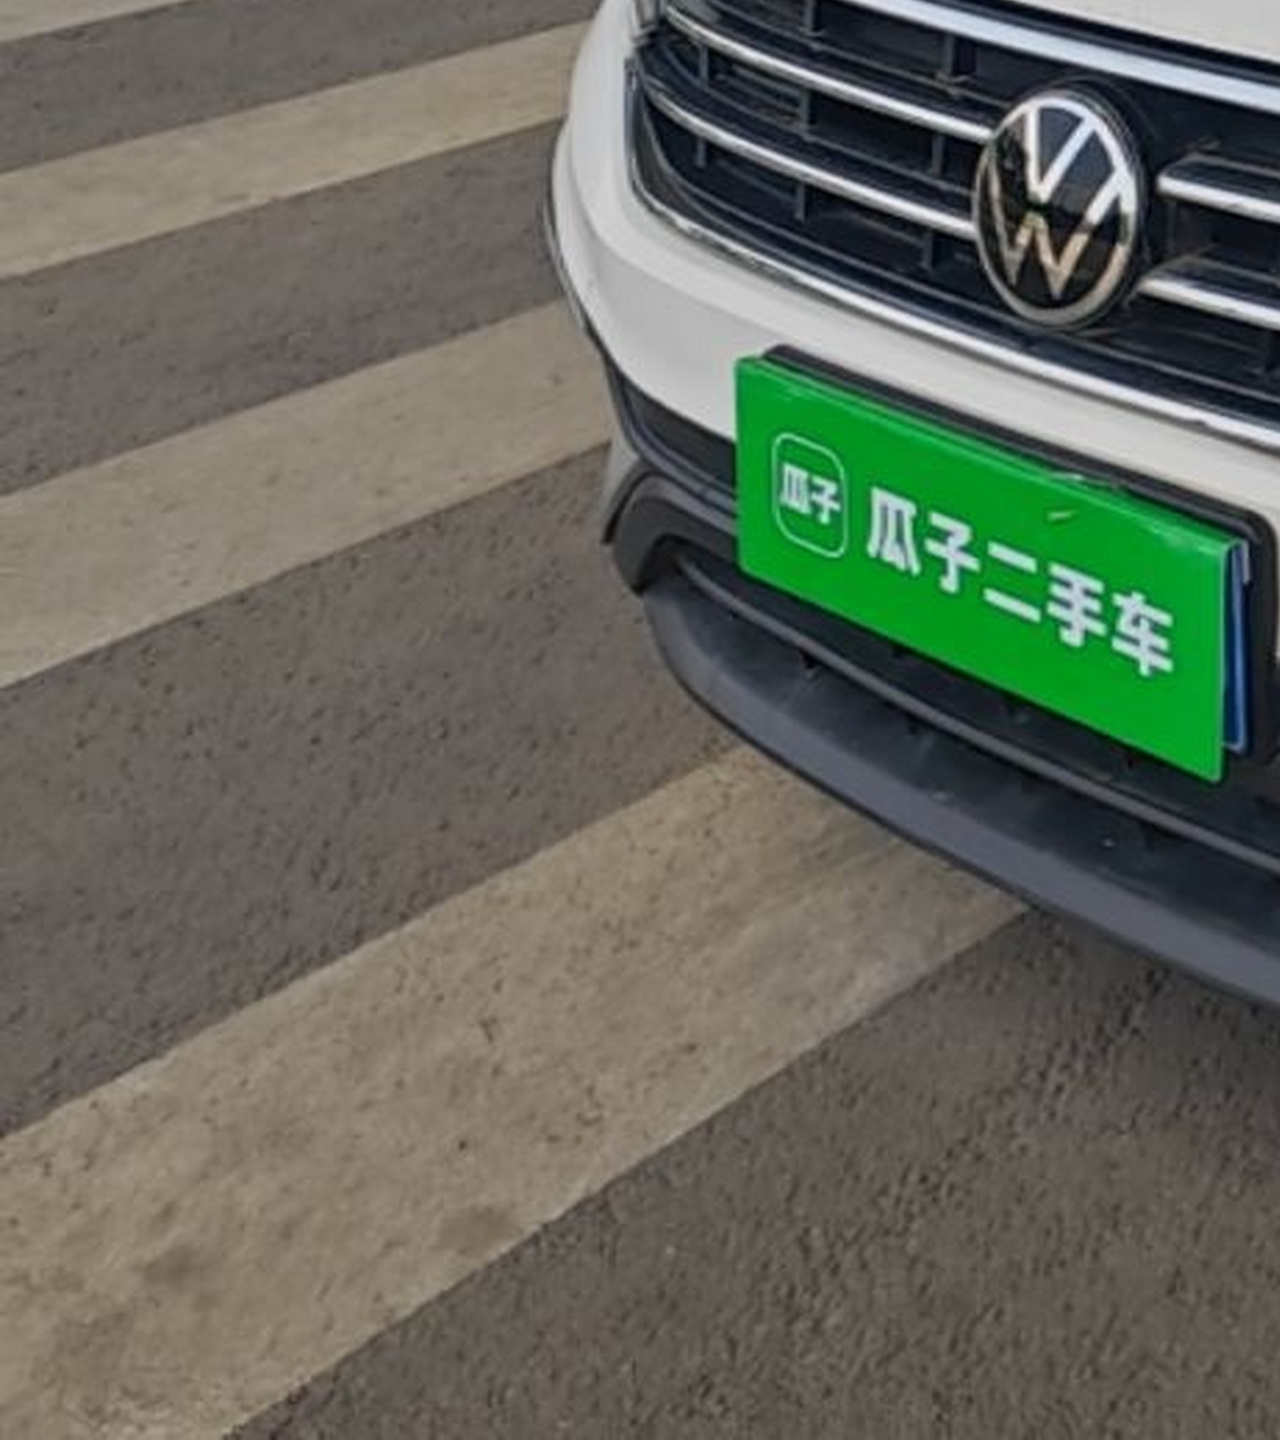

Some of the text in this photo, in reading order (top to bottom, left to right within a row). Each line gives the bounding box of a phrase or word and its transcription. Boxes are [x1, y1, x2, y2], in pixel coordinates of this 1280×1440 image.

[778, 463, 842, 525] 瓜子
[866, 486, 1174, 677] 瓜子二手车
